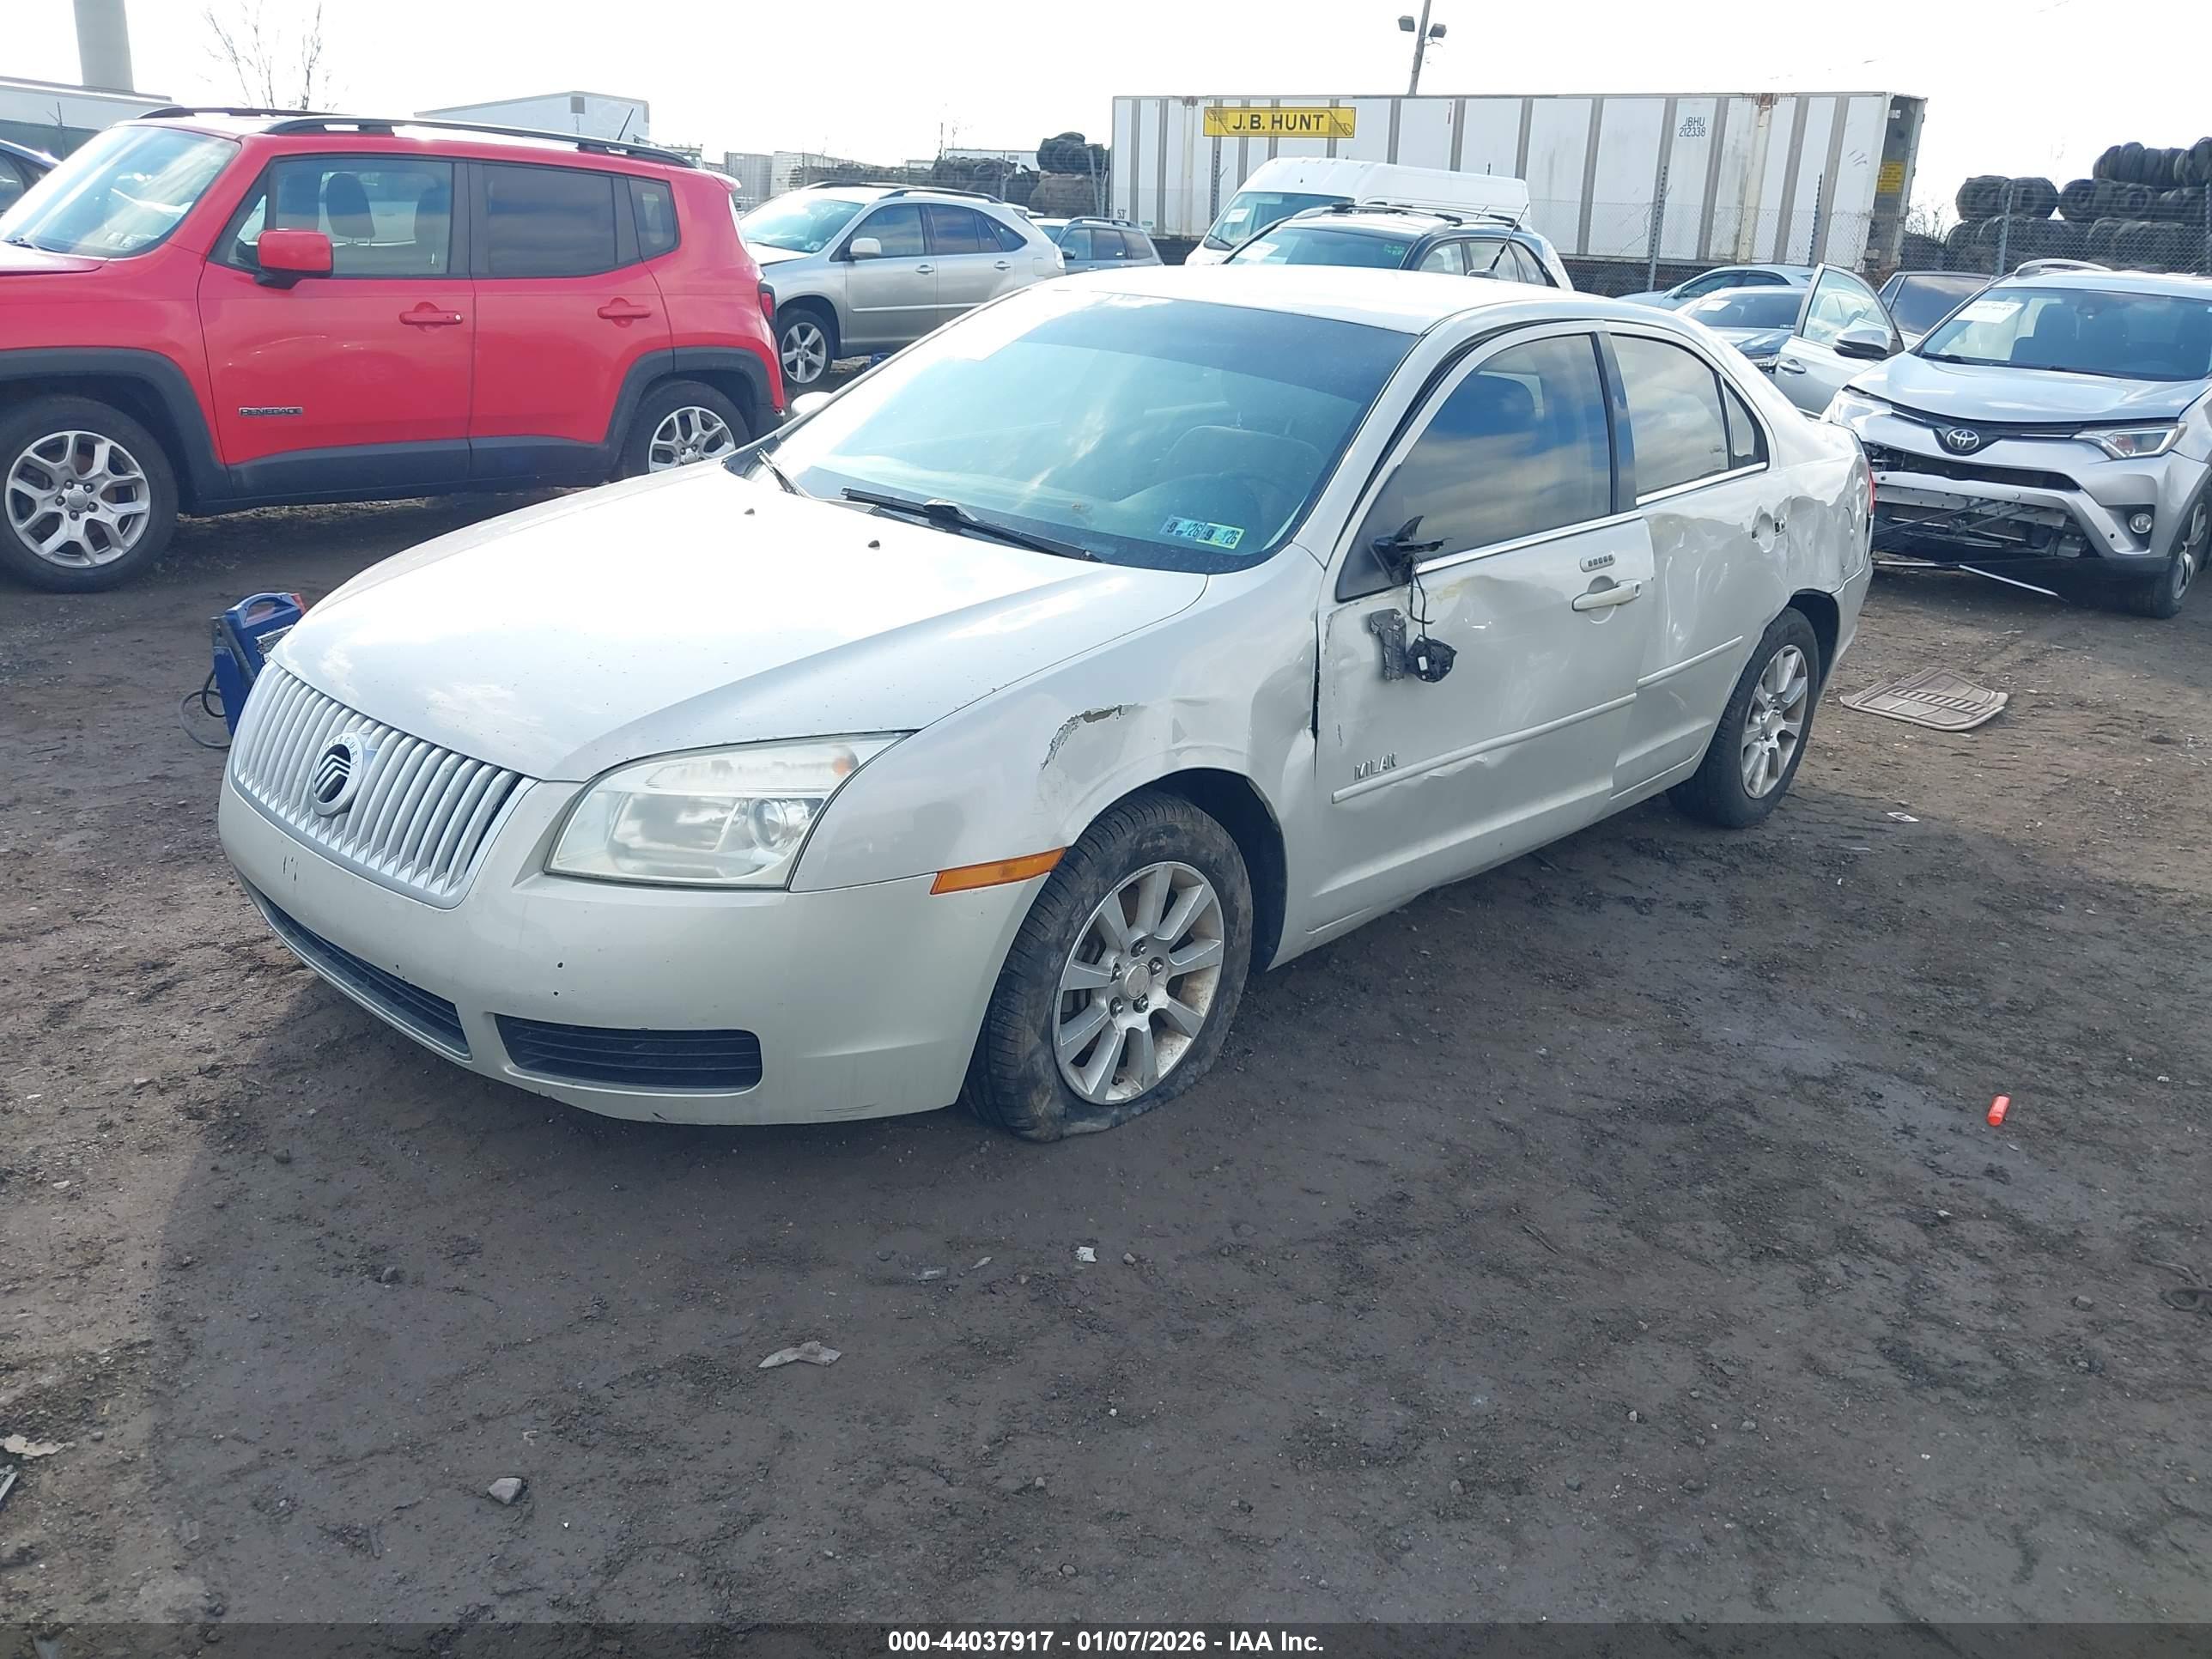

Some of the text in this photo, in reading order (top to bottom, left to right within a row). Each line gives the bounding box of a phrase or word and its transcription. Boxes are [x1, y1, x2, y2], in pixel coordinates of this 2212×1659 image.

[1271, 114, 1324, 131] HUNT
[1683, 117, 1705, 127] JBHU
[1679, 127, 1706, 137] 212338
[239, 406, 303, 417] RENEGADE
[1354, 753, 1397, 781] MILAN
